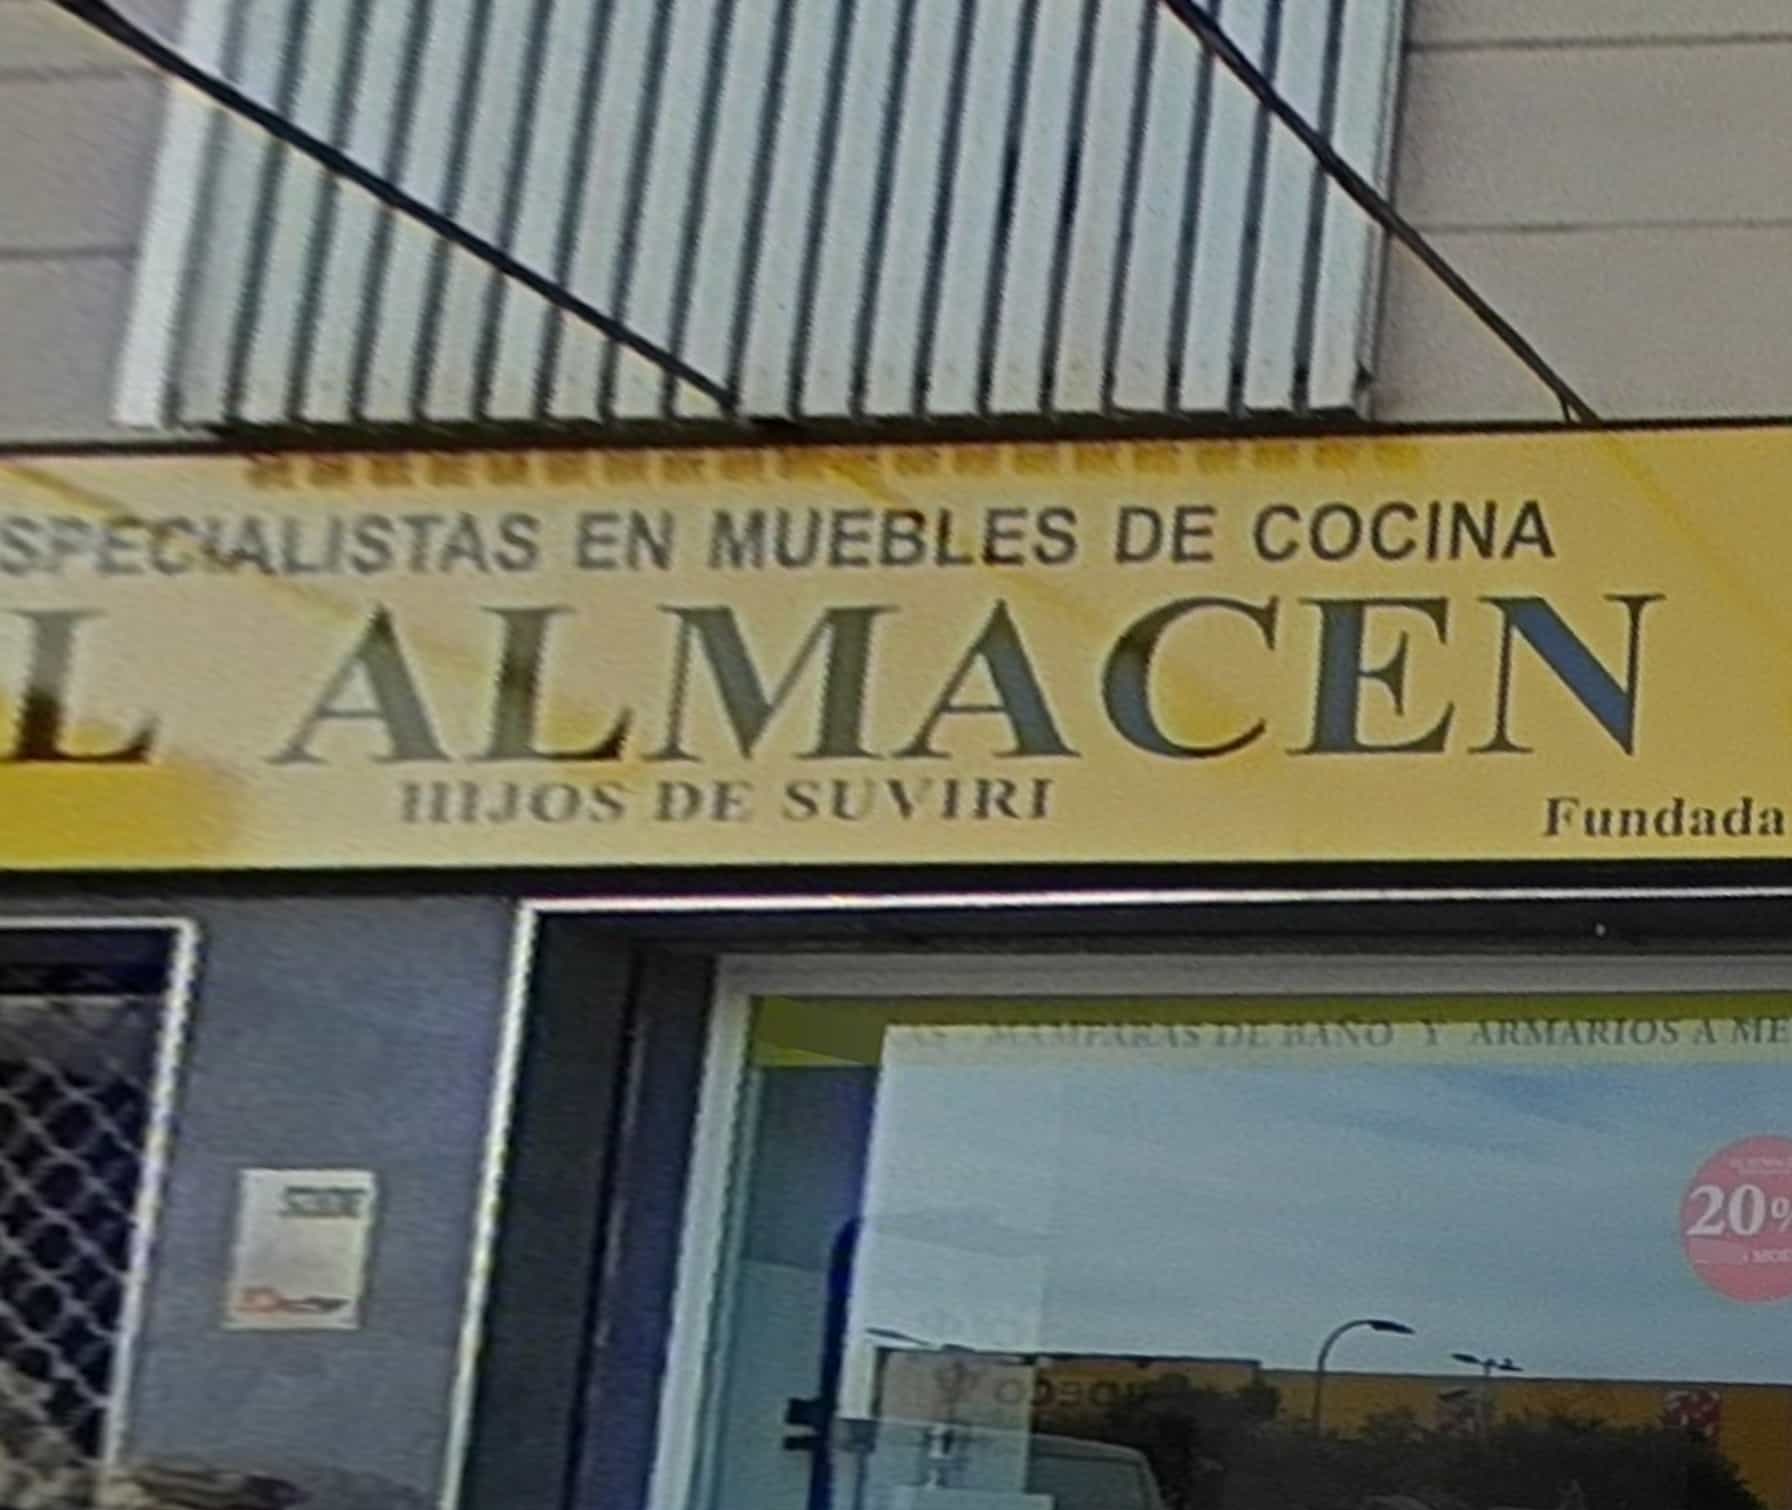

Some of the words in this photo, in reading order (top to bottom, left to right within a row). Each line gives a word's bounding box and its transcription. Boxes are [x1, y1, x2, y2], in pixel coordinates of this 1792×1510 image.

[0, 511, 539, 577] SPECIALISTAS
[575, 511, 673, 571] EN
[709, 506, 1078, 568] MUEBLES
[1115, 505, 1215, 564] DE
[1253, 499, 1556, 562] COCINA
[2, 606, 160, 764] L
[262, 594, 1665, 764] ALMACEN
[401, 779, 626, 824] HIJOS
[654, 778, 754, 823] DE
[783, 776, 1053, 822] SUVIRI
[1543, 796, 1786, 838] Fundada
[1471, 1016, 1678, 1047] ARMARIOS
[1696, 1016, 1719, 1045] A
